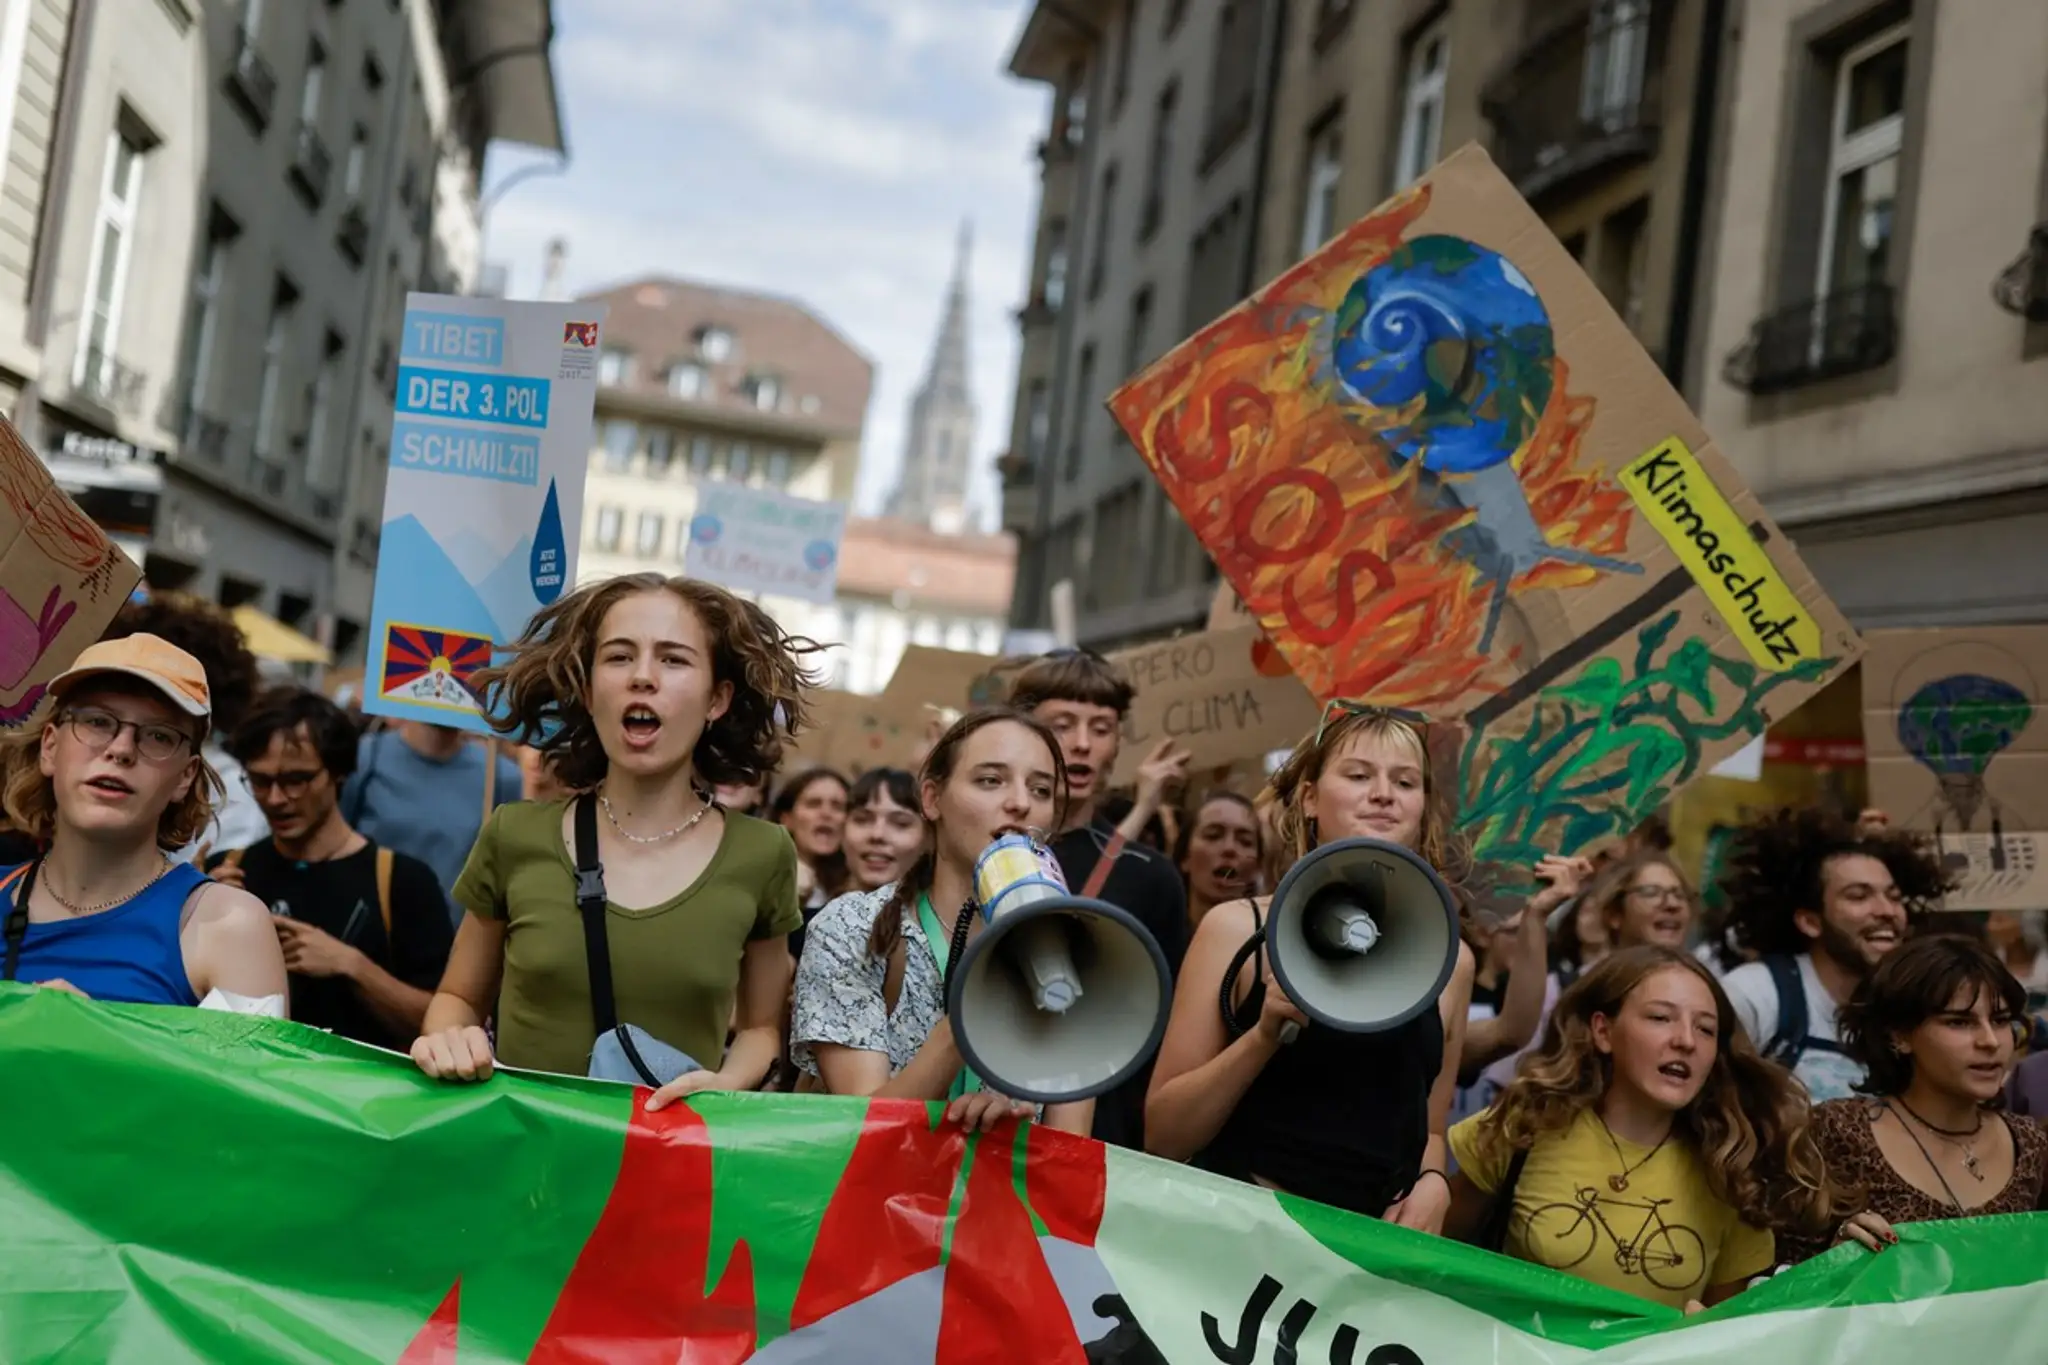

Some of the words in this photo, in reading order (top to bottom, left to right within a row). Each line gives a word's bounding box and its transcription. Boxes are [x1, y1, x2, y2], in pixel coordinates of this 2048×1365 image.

[414, 321, 497, 359] TIBET
[407, 376, 471, 414] DER
[478, 383, 499, 417] 3.
[505, 385, 542, 421] POL
[400, 432, 535, 478] SCHMILZT!
[1153, 381, 1396, 647] SOS
[1634, 448, 1800, 665] Klimaschutz
[1161, 688, 1263, 737] CLIMA
